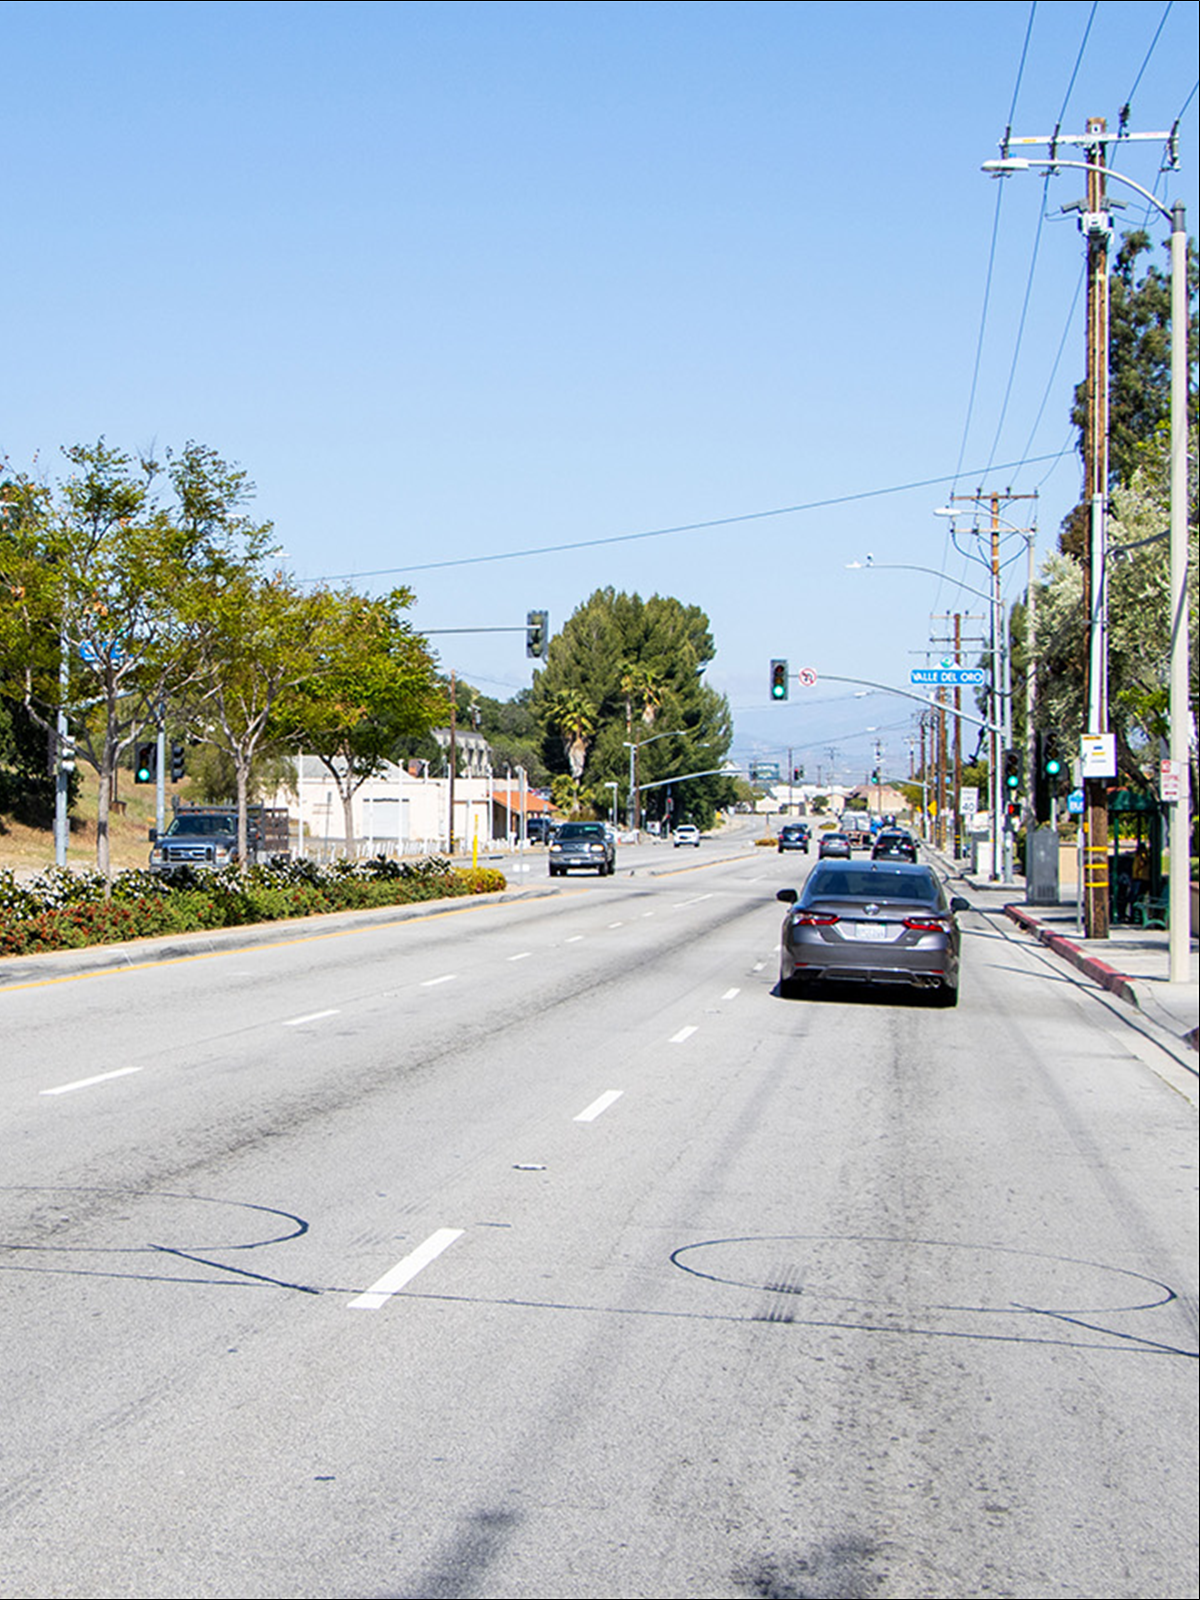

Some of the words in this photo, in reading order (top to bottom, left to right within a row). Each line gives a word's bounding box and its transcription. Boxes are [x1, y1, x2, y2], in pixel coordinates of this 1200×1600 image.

[911, 672, 938, 682] VALLE
[941, 672, 958, 682] DEL
[960, 672, 983, 682] ORO
[962, 802, 975, 812] 40
